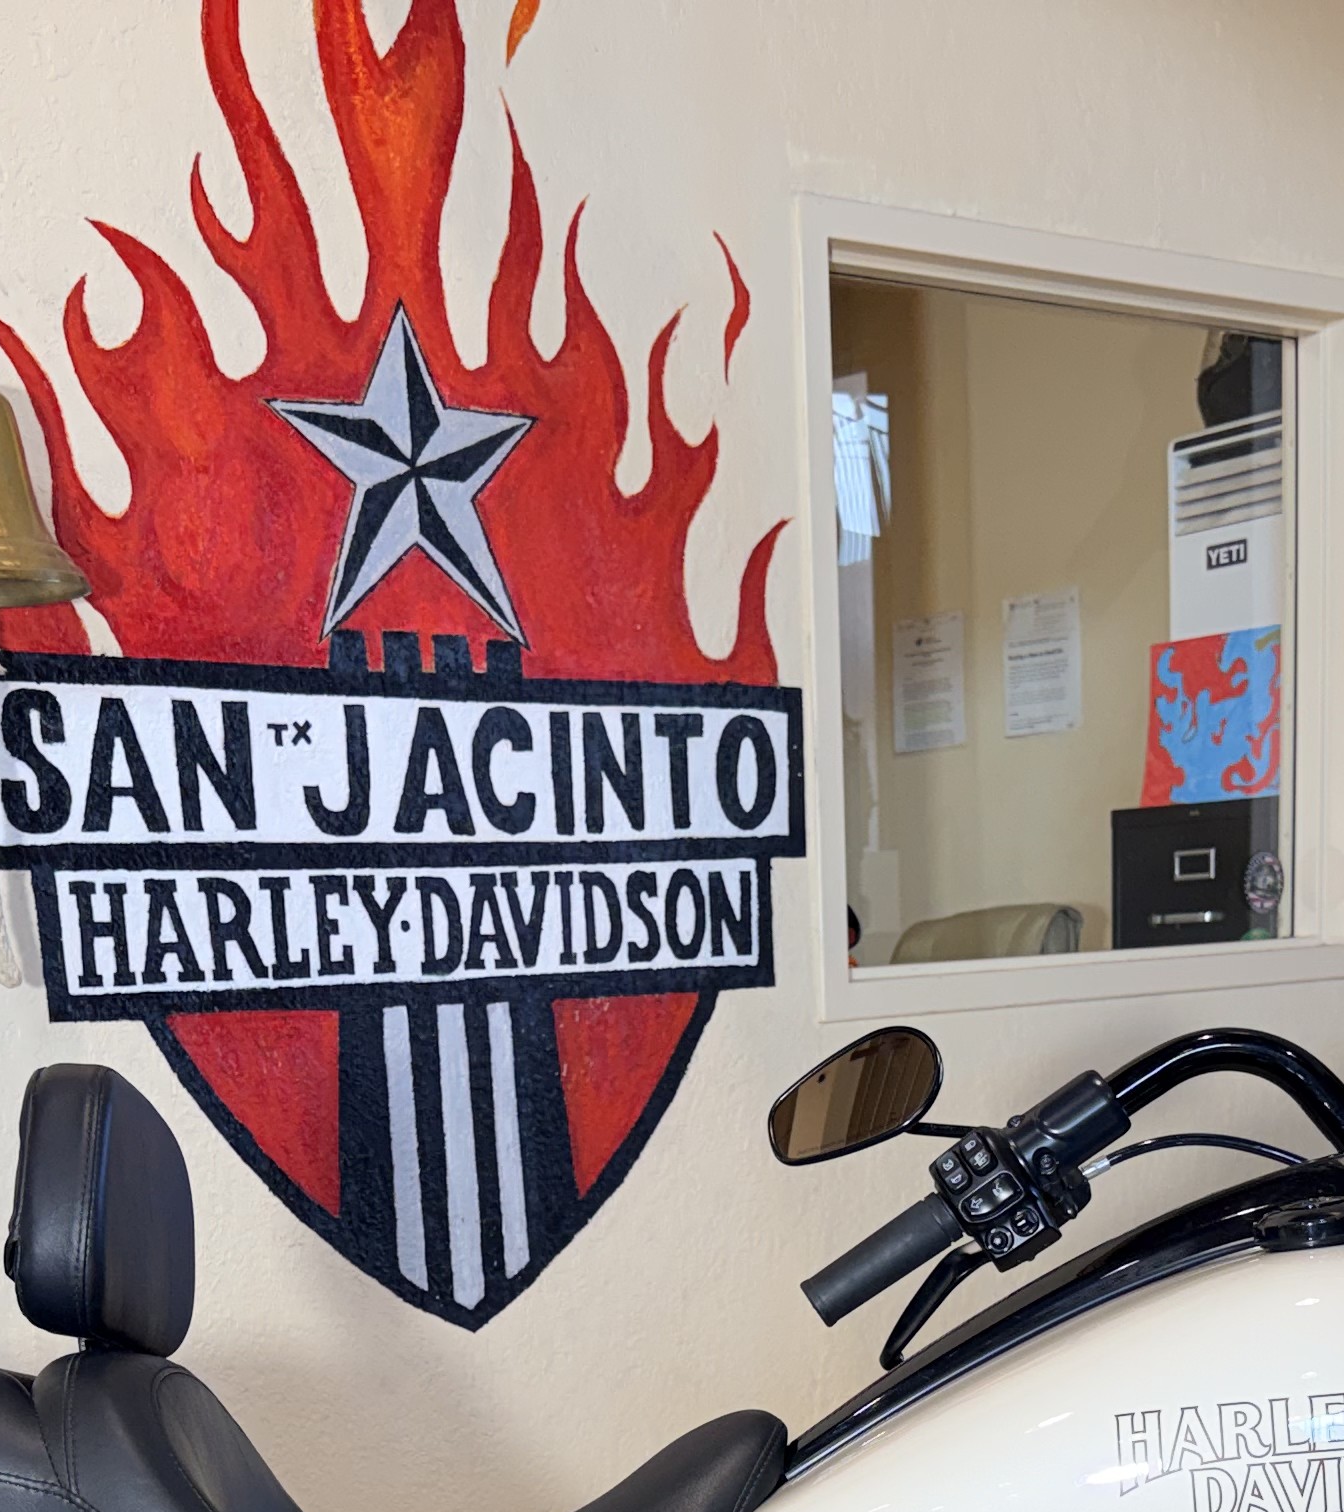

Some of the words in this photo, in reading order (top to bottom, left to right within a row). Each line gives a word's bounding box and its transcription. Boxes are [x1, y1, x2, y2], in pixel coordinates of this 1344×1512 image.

[1208, 543, 1245, 566] YETI
[0, 689, 257, 834] SAN
[267, 721, 312, 747] TX
[303, 704, 778, 837] JACINTO
